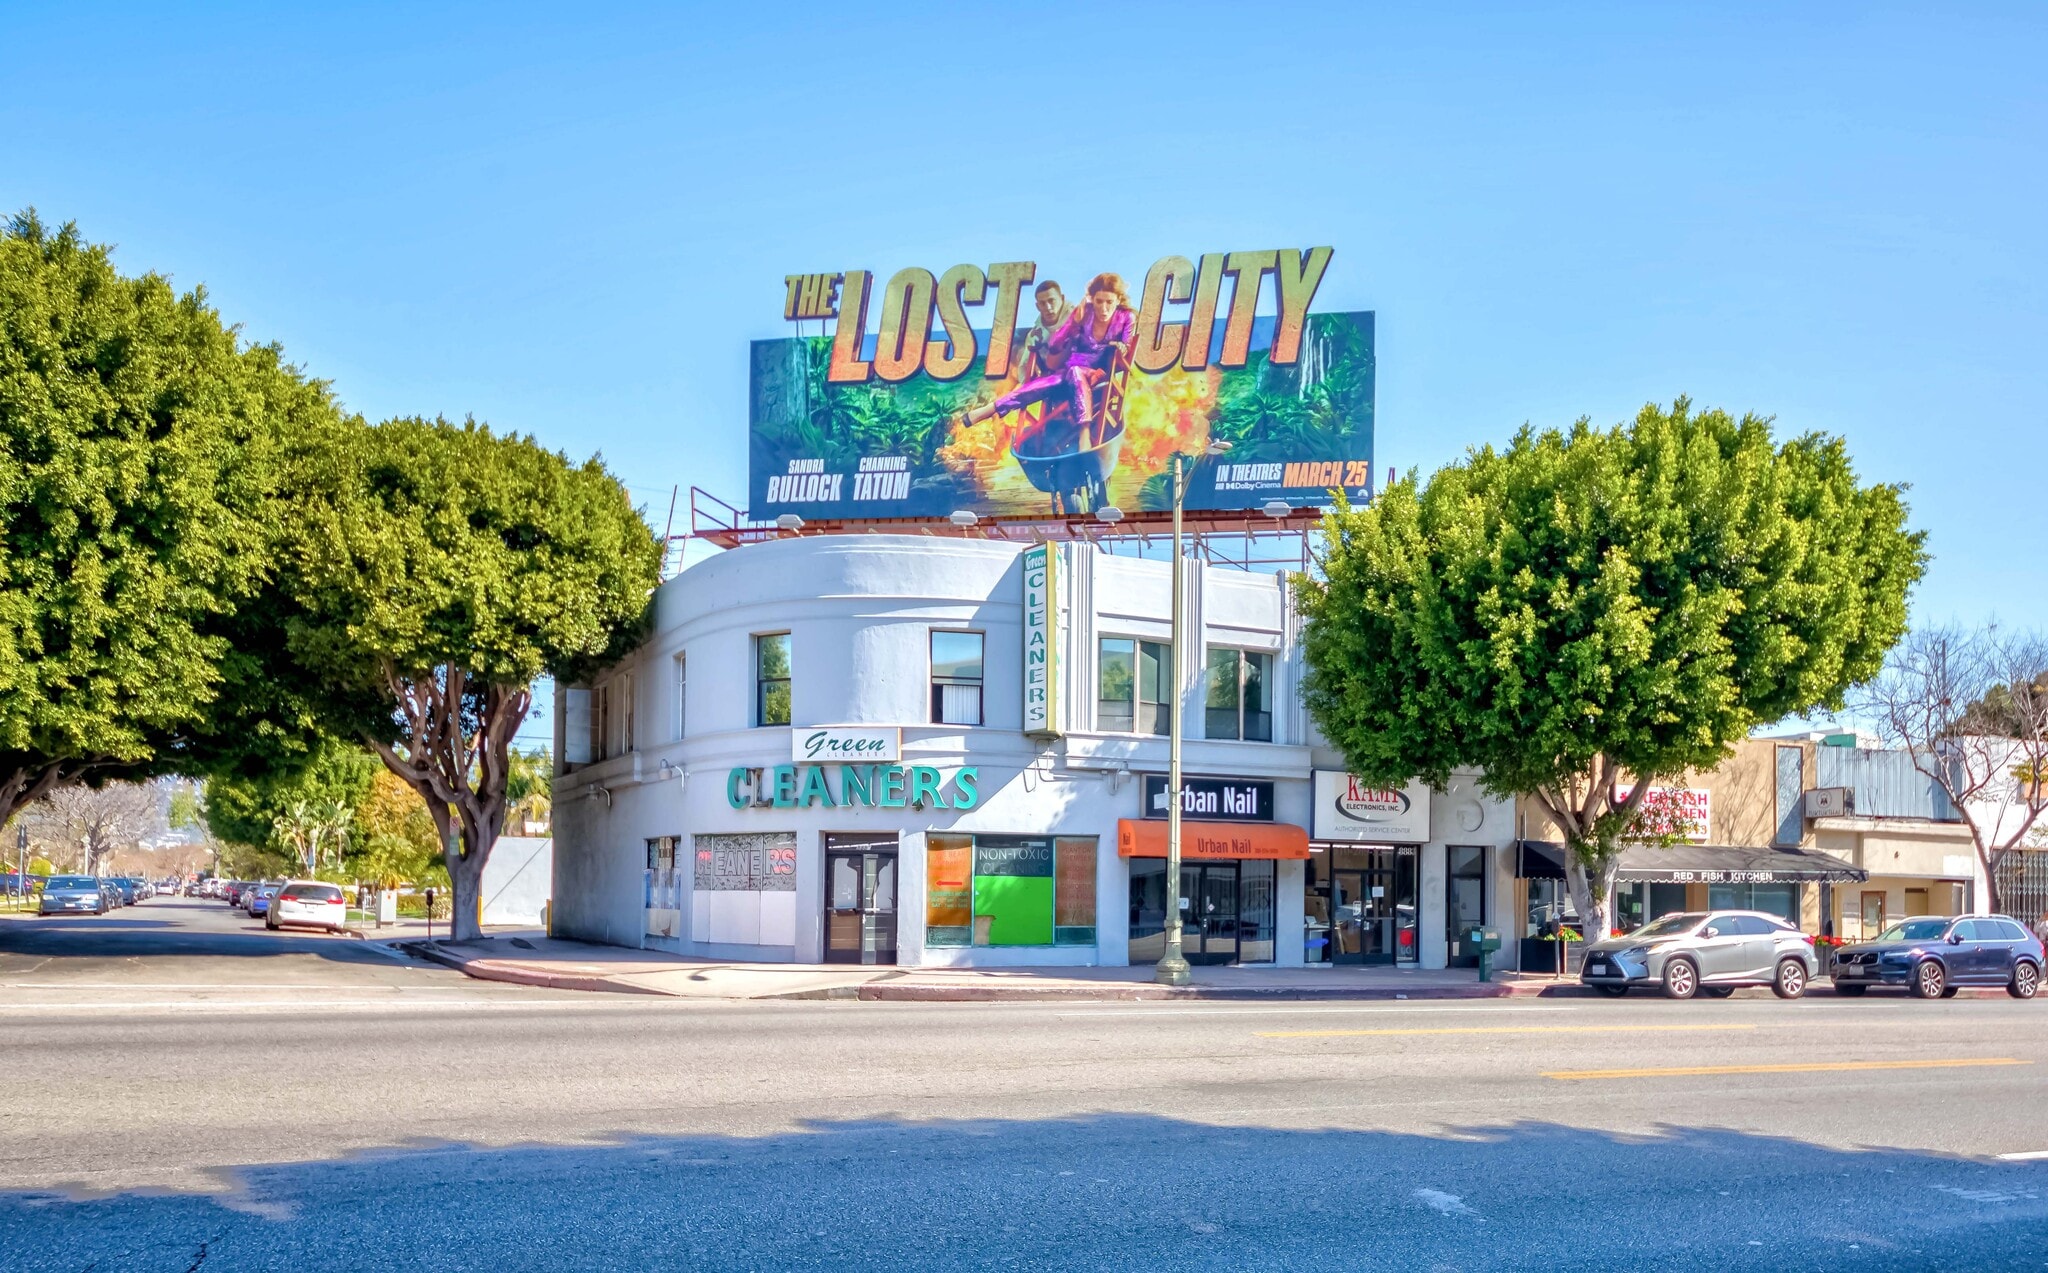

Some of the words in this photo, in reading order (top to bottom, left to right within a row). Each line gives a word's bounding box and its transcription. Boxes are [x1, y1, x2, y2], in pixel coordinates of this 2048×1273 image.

[784, 272, 841, 321] THE
[829, 261, 1037, 383] LOST
[1134, 246, 1335, 373] CITY
[788, 458, 825, 475] SANDRA
[859, 456, 907, 472] CHANNING
[1216, 464, 1230, 482] IN
[1231, 463, 1282, 482] THEATRES
[1283, 461, 1343, 488] MARCH
[1344, 460, 1368, 487] 25
[766, 473, 844, 503] BULLOCK
[853, 471, 911, 501] TATUM
[1235, 482, 1255, 491] Dolby
[1255, 481, 1281, 489] Cinema
[1026, 553, 1046, 571] Green
[1028, 571, 1045, 722] CLEANERS
[804, 731, 886, 759] Green
[727, 764, 979, 810] CLEANERS
[1223, 786, 1257, 815] Nail
[1346, 803, 1387, 812] ELECTRONICS,
[1368, 826, 1389, 834] SERVICE
[979, 848, 1049, 861] NON-TOXIC
[1197, 838, 1228, 854] Urban
[1231, 839, 1252, 854] Nail
[982, 862, 1046, 875] CLEANING
[1673, 872, 1694, 881] RED
[1701, 872, 1724, 881] FISH
[1731, 872, 1773, 881] KITCHEN
